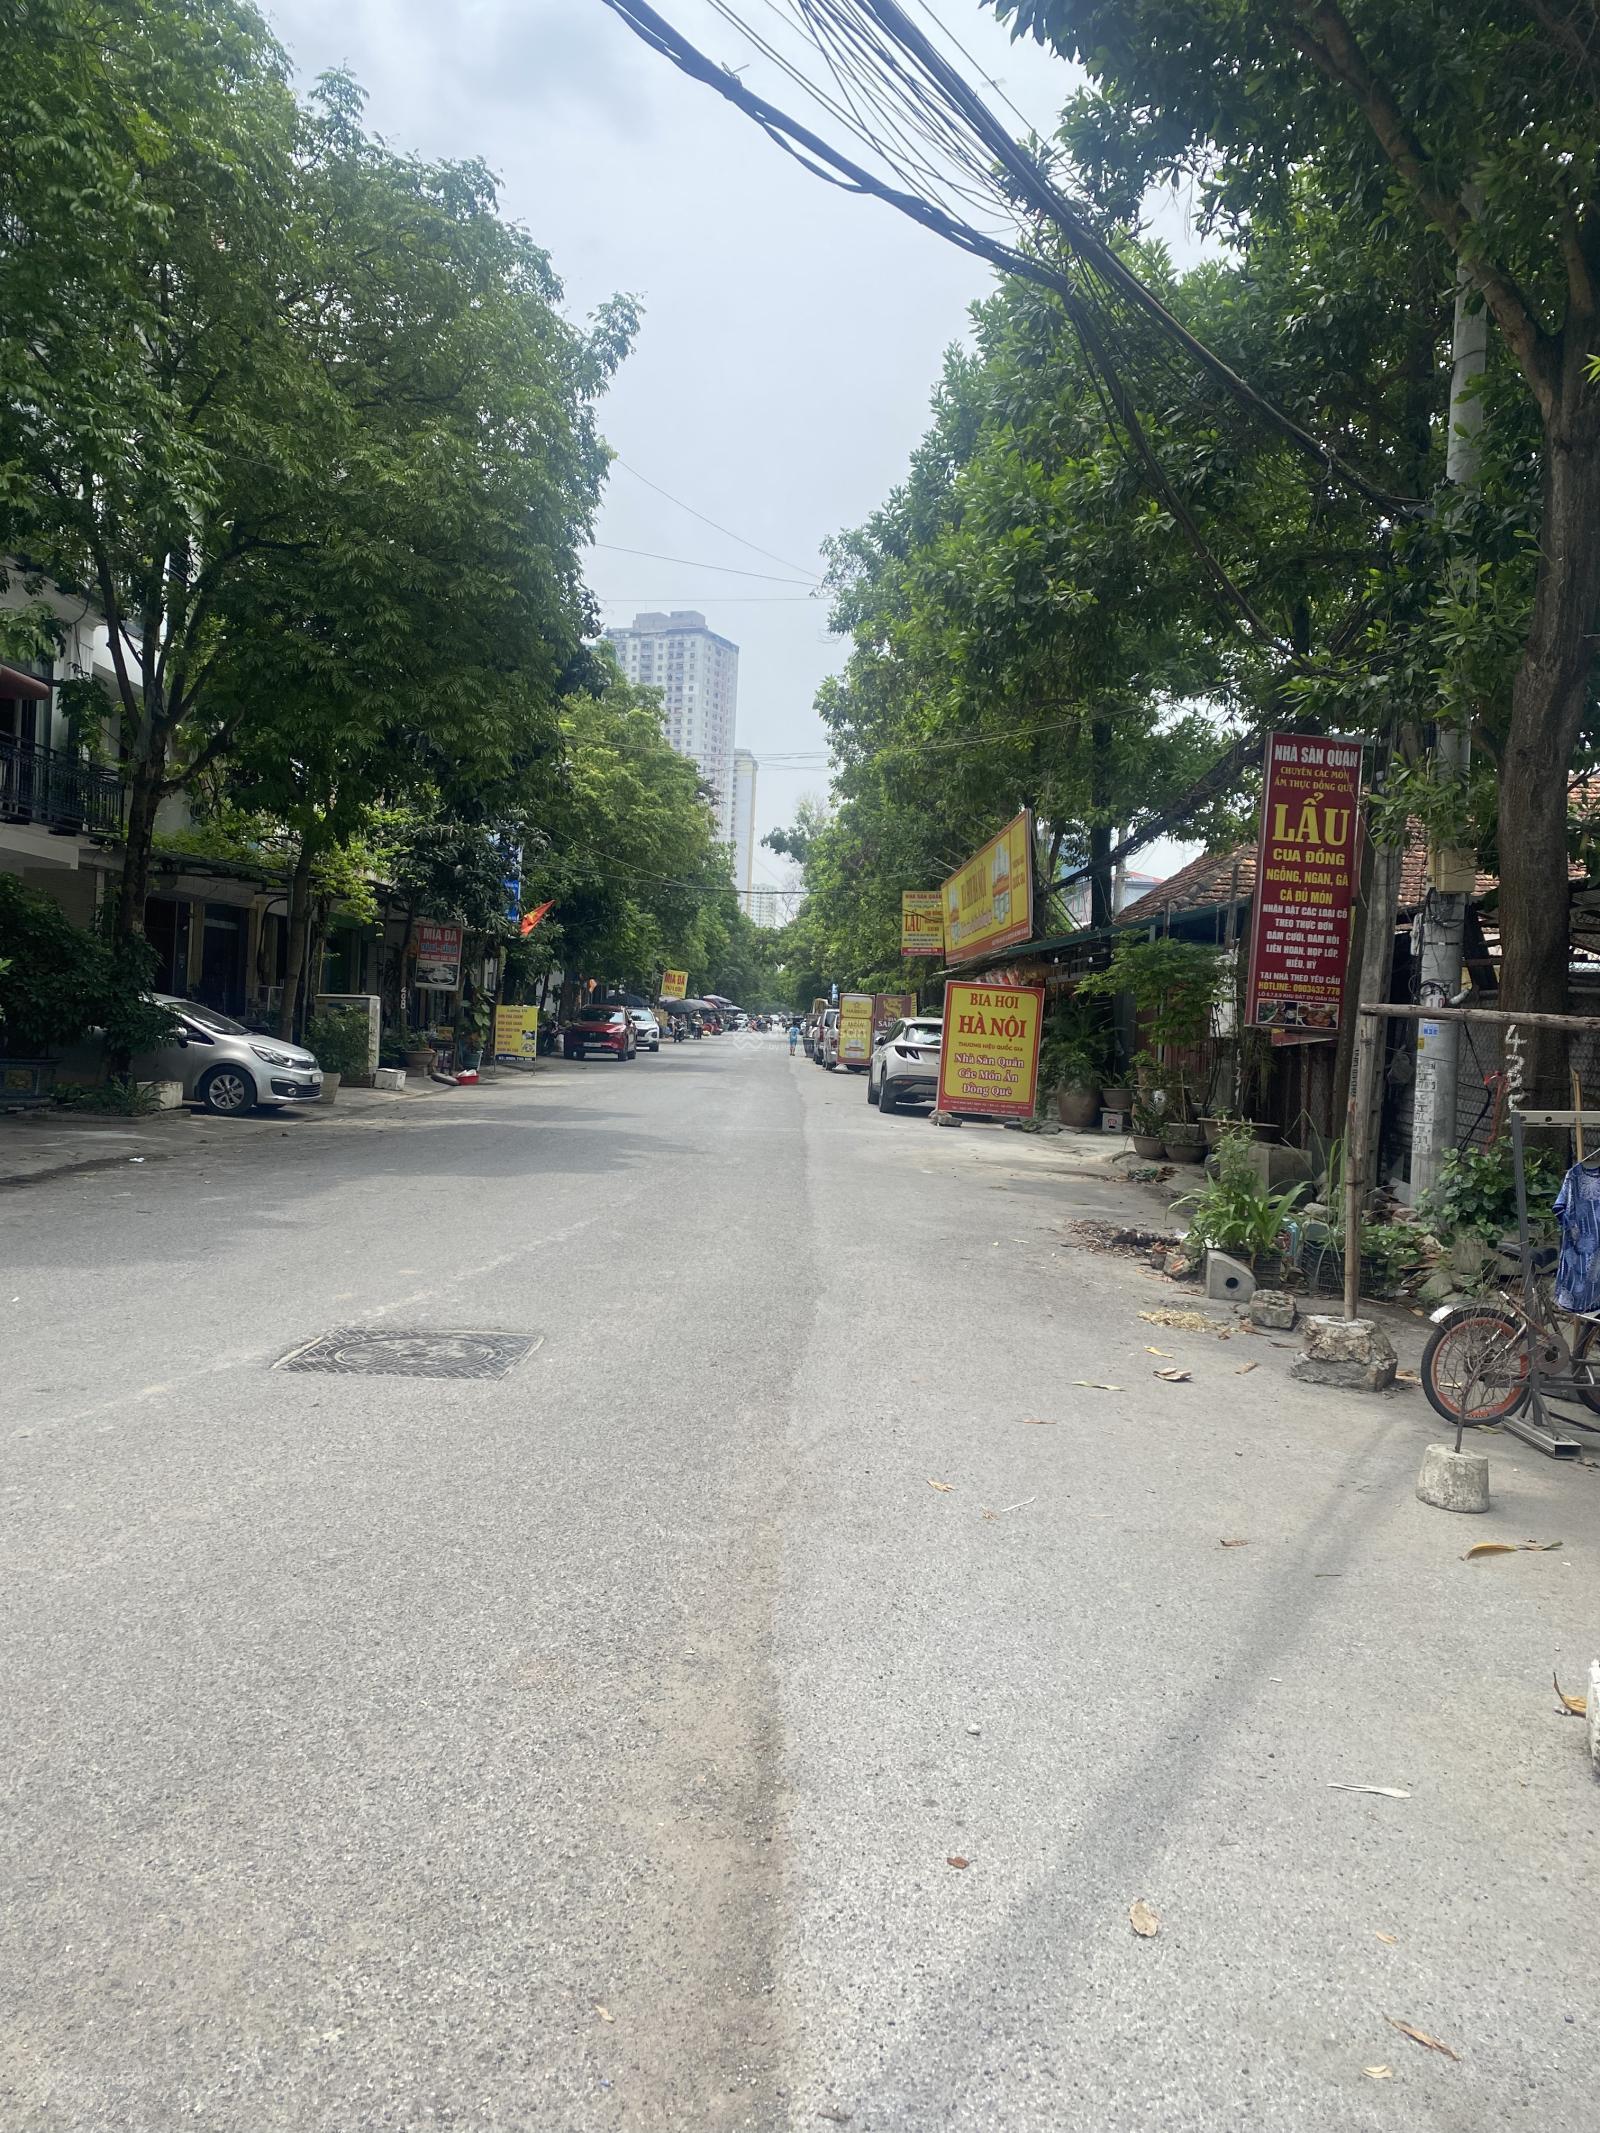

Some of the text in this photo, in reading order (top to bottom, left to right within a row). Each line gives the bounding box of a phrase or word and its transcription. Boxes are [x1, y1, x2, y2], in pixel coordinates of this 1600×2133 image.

[1273, 848, 1302, 863] CUA
[970, 992, 1019, 1009] BIA HƠI
[958, 1011, 1028, 1042] HÀ NỘI
